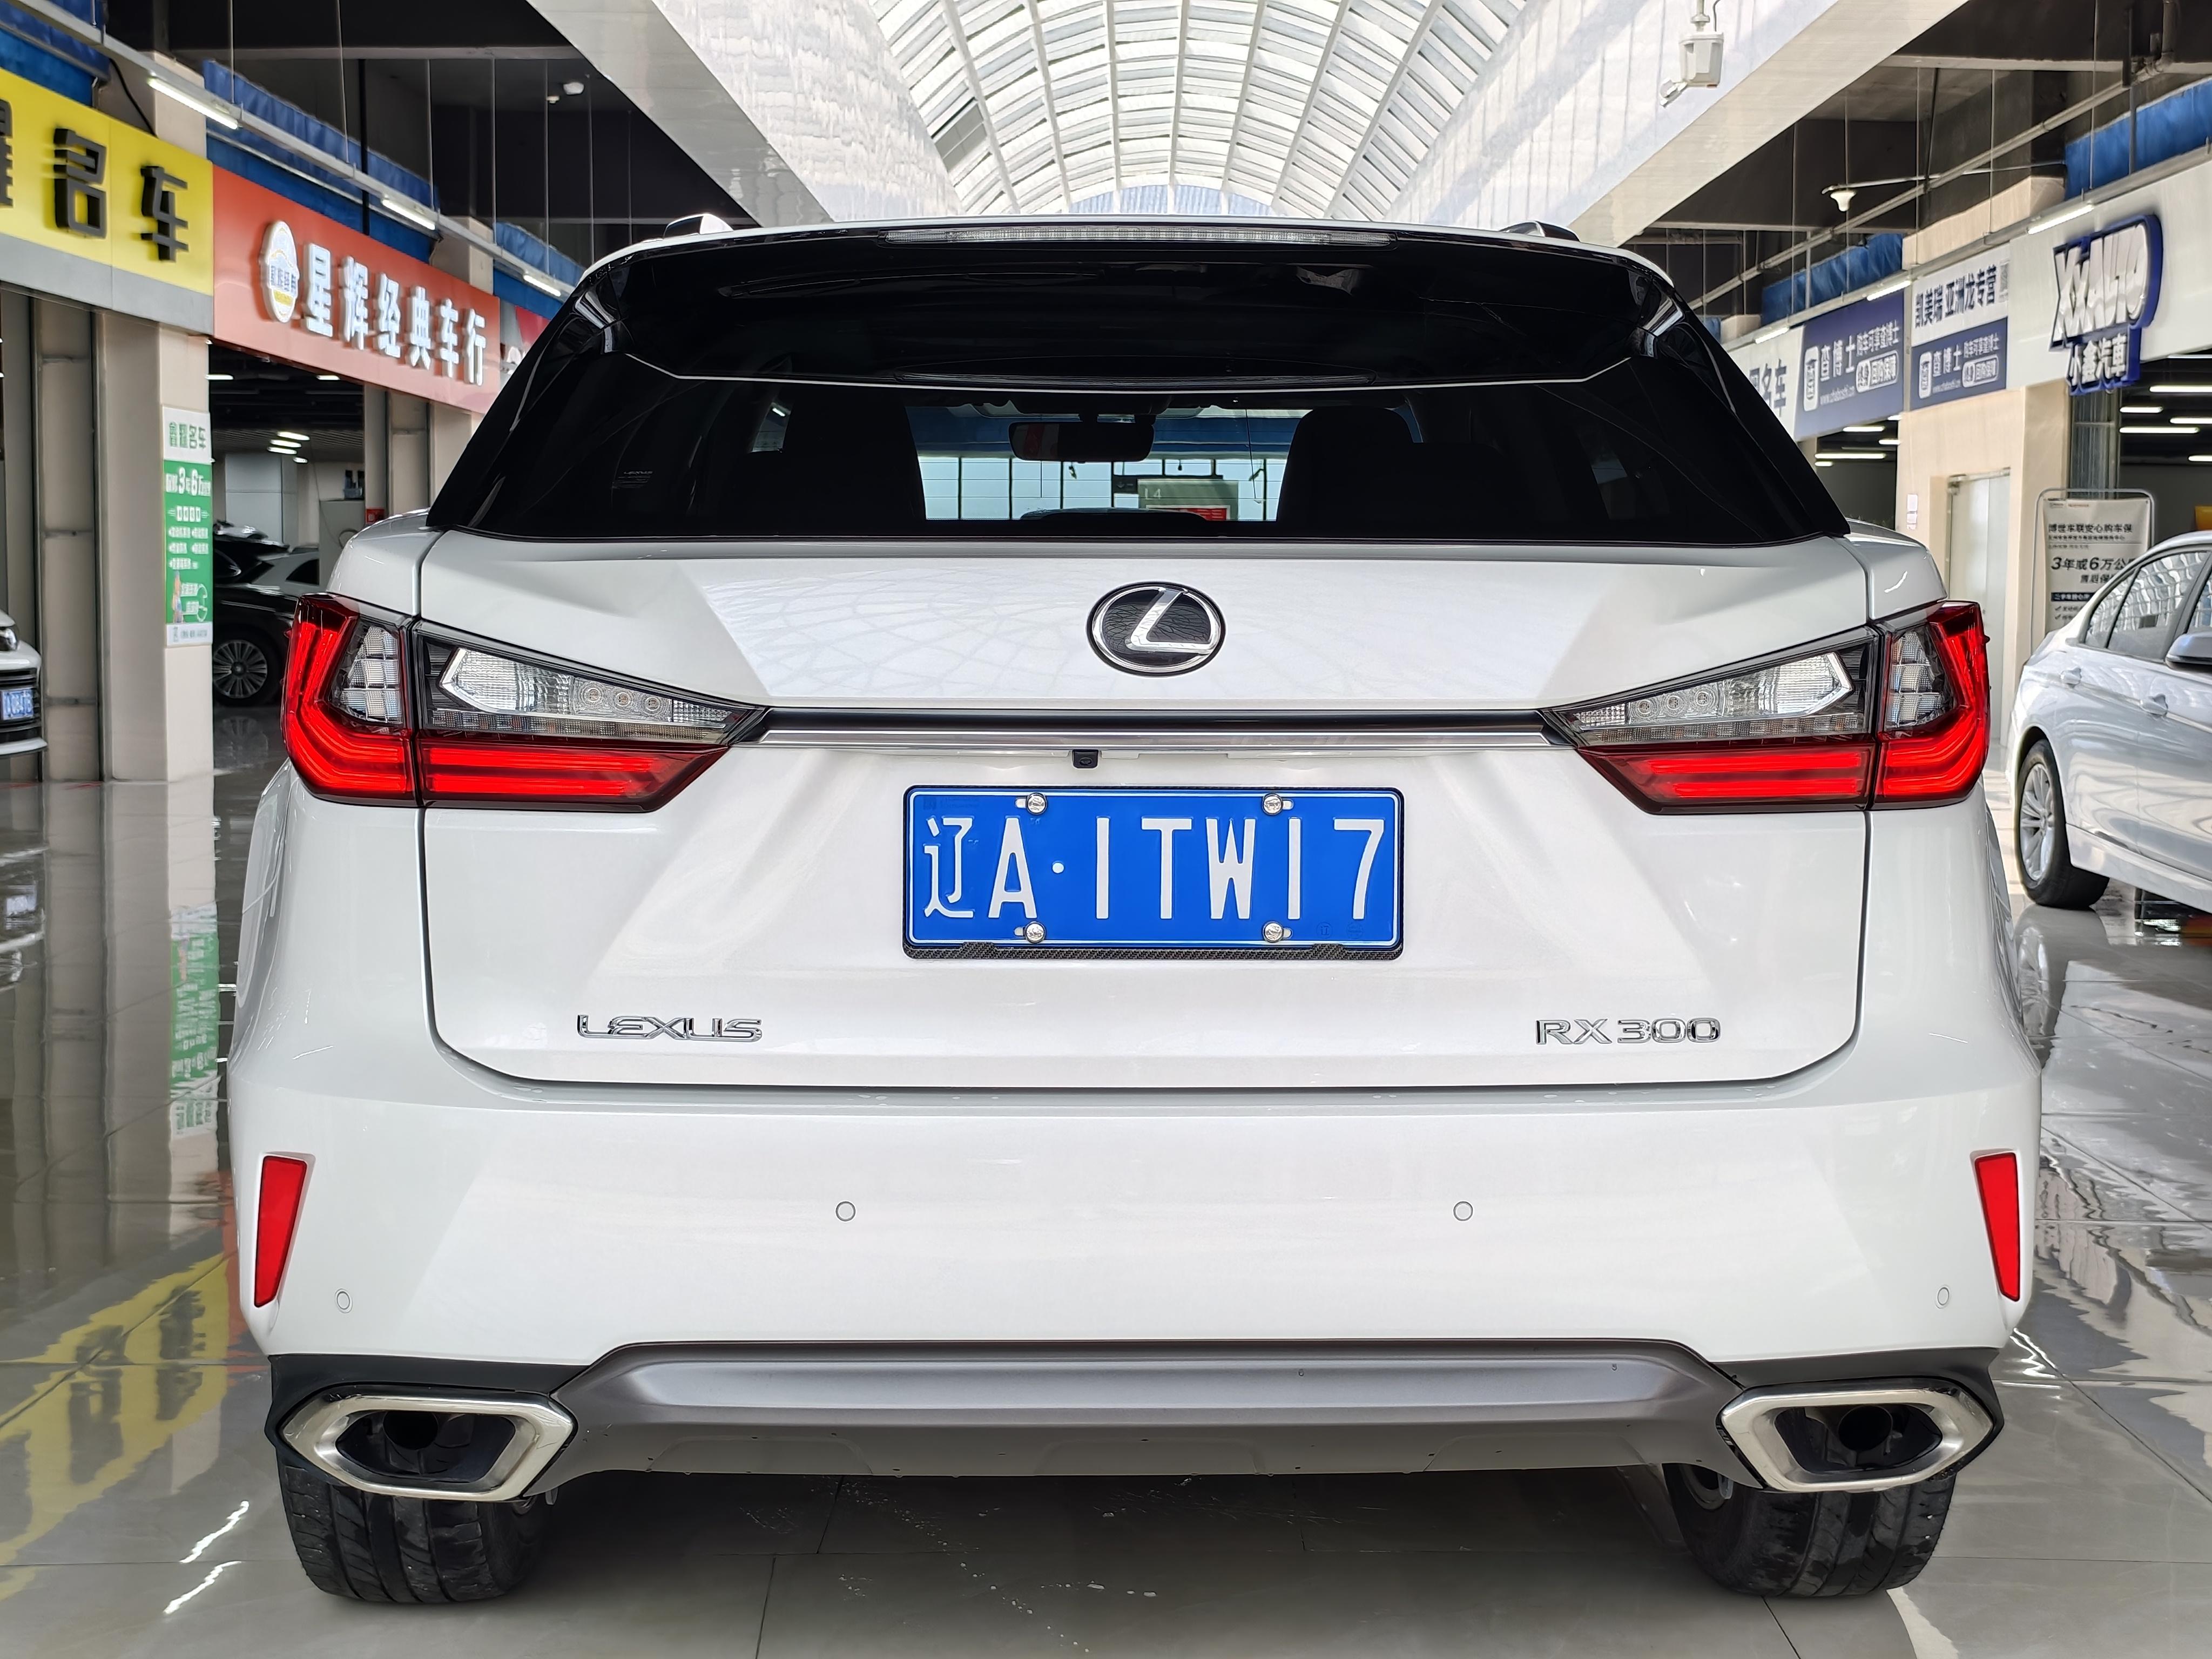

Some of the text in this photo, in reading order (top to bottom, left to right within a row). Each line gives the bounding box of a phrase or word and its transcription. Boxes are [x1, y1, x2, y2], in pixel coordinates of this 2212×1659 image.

[304, 243, 486, 387] 星辉经典车行
[1915, 284, 1944, 329] 凯美瑞
[1945, 264, 1997, 319] 亚洲龙专营
[1820, 335, 1856, 382] 查博士
[577, 1014, 763, 1043] LEXUS
